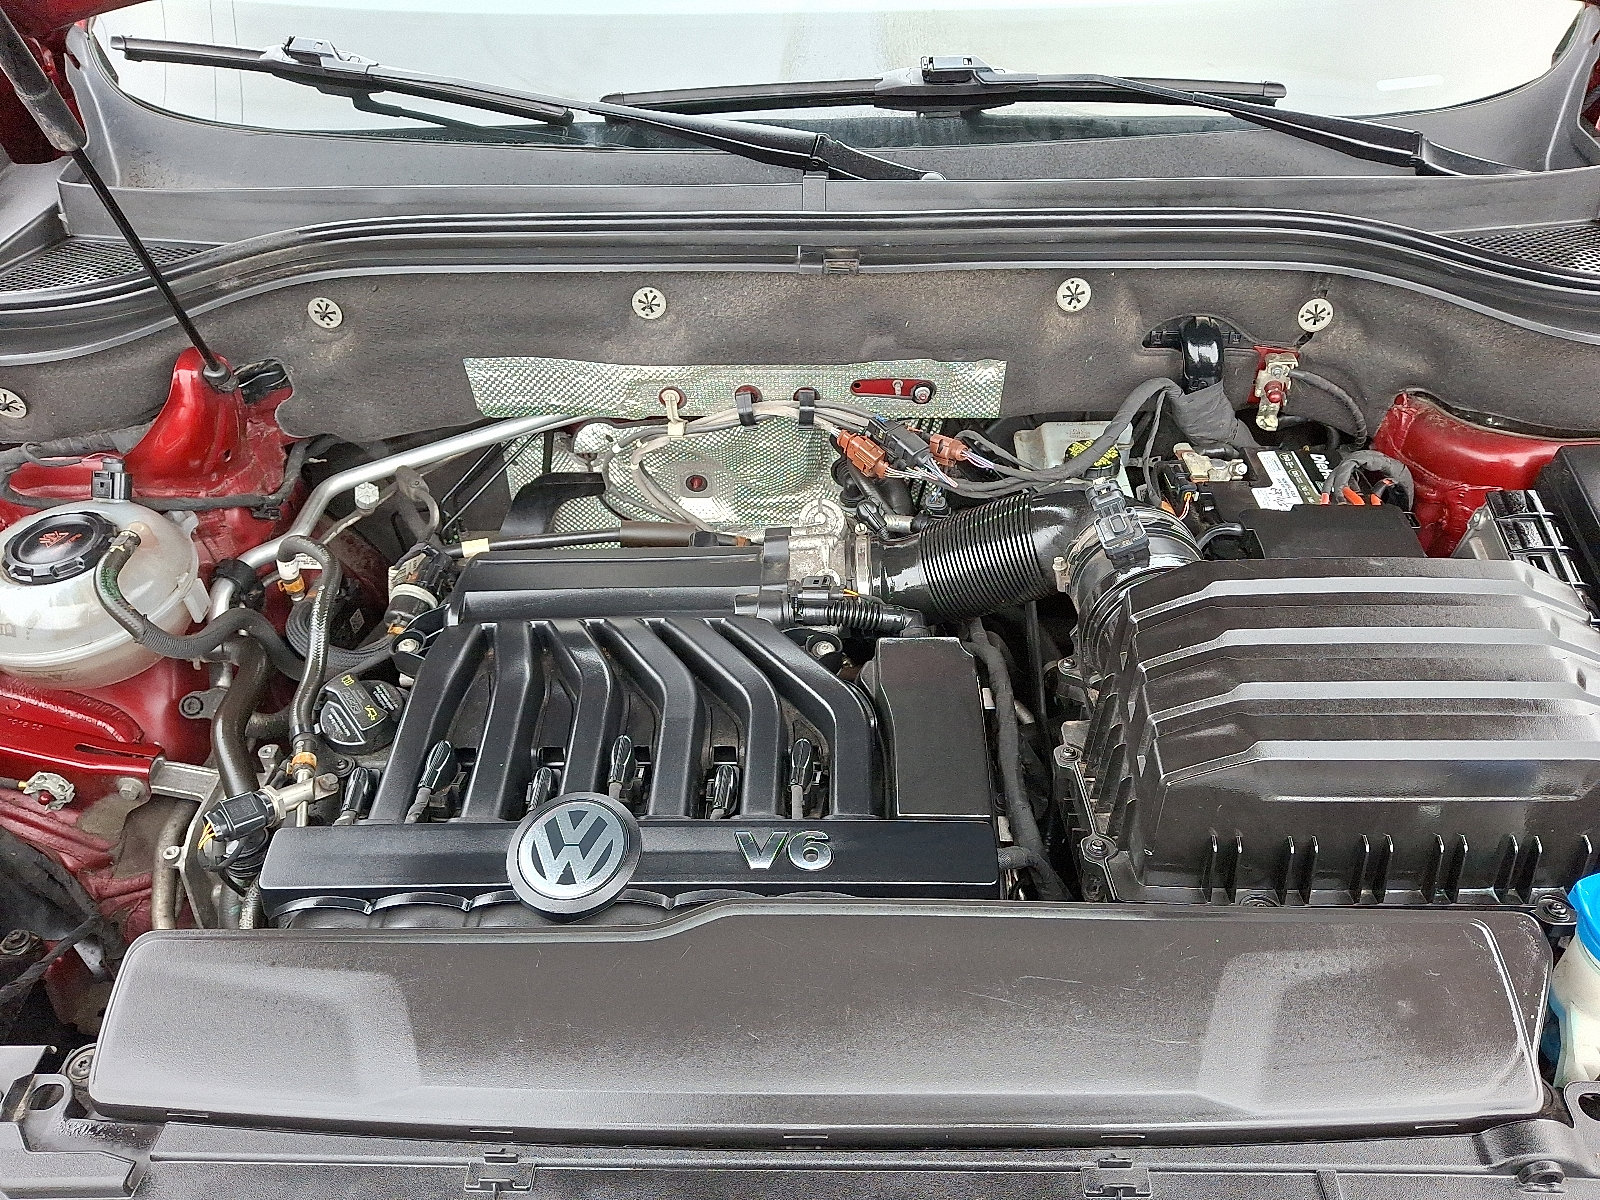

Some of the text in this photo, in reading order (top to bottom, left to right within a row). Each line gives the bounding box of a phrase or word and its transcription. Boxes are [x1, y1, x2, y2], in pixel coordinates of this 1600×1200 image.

[1310, 454, 1334, 480] Dieh
[522, 805, 624, 892] VW
[735, 830, 834, 871] V6
